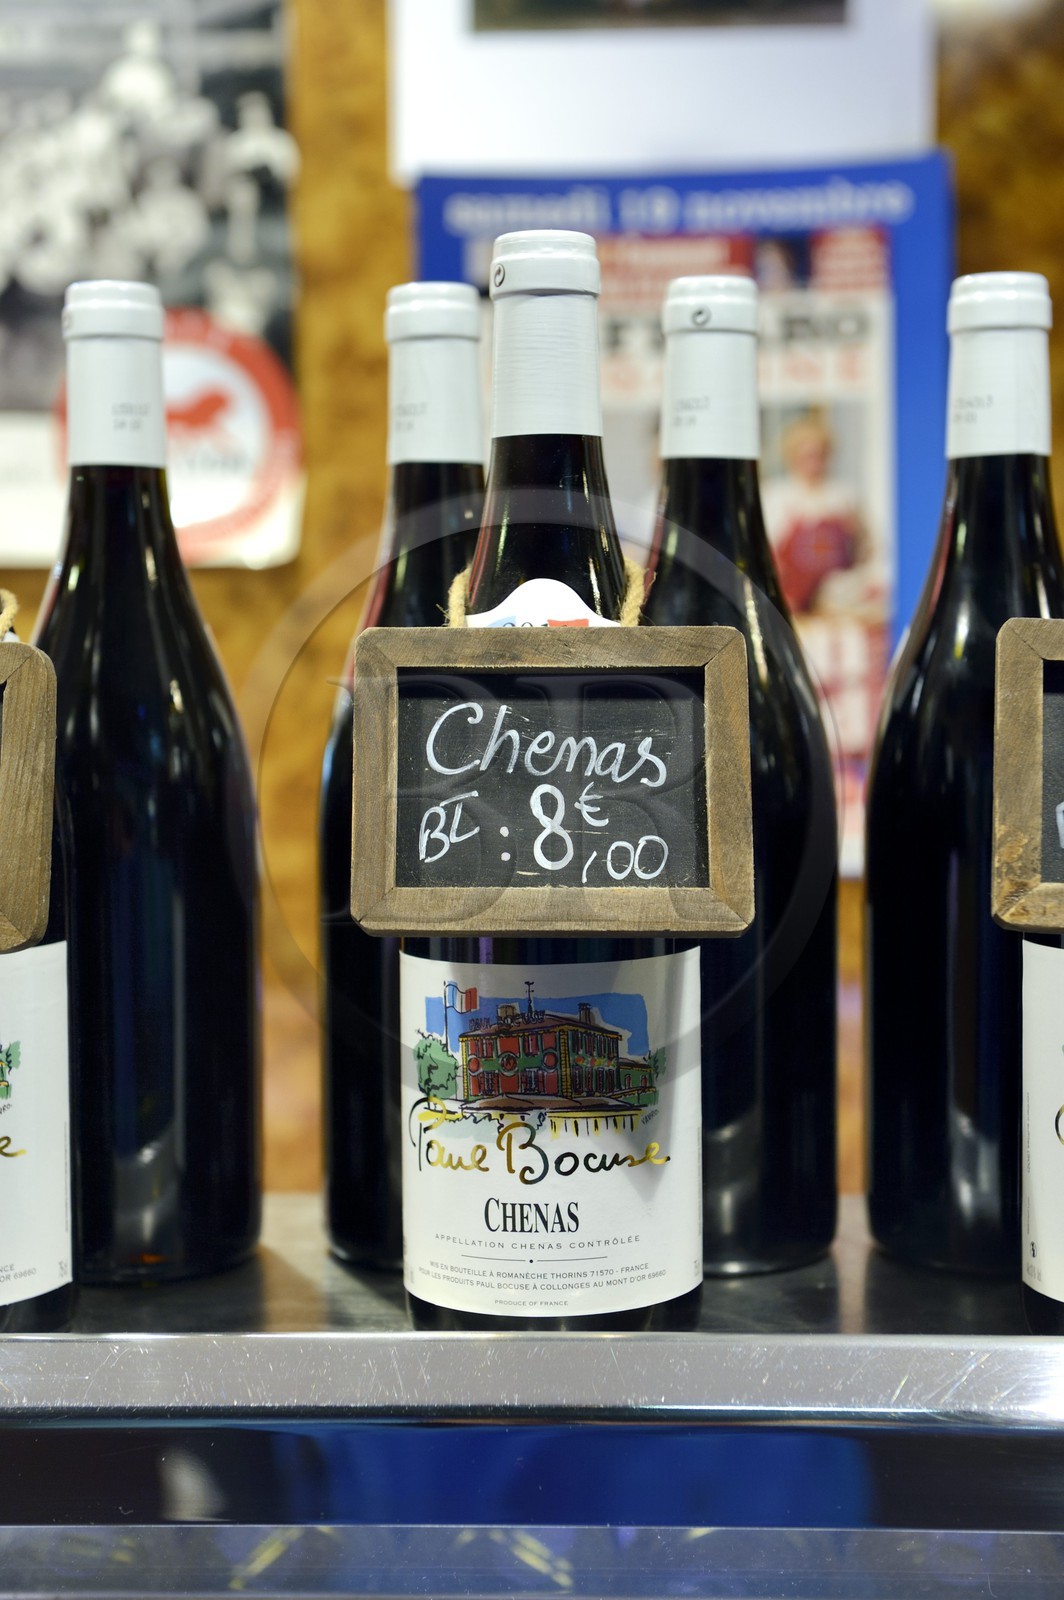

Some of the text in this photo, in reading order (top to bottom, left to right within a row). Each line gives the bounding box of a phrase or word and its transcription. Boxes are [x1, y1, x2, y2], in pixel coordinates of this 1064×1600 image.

[425, 702, 667, 788] Chenas
[484, 1197, 580, 1234] CHENAS
[435, 1233, 641, 1250] APPELLATION CHENAS CONTRÔLÉE
[418, 1266, 430, 1276] POUR
[431, 1271, 441, 1280] LES
[442, 1274, 474, 1287] PRODUITS
[476, 1280, 495, 1289] PAUL
[497, 1282, 530, 1291] BOCUSE
[540, 1281, 591, 1291] COLLONGES
[593, 1280, 604, 1288] AU
[606, 1277, 628, 1287] MONT
[629, 1274, 646, 1284] D'OR
[429, 1260, 440, 1268] MIS
[440, 1263, 449, 1271] EN
[450, 1265, 487, 1278] BOUTEILLE
[550, 1271, 588, 1280] THORINS
[590, 1269, 615, 1278] 71570
[620, 1263, 649, 1274] FRANCE
[494, 1299, 527, 1307] PRODUCE
[528, 1299, 538, 1307] OF
